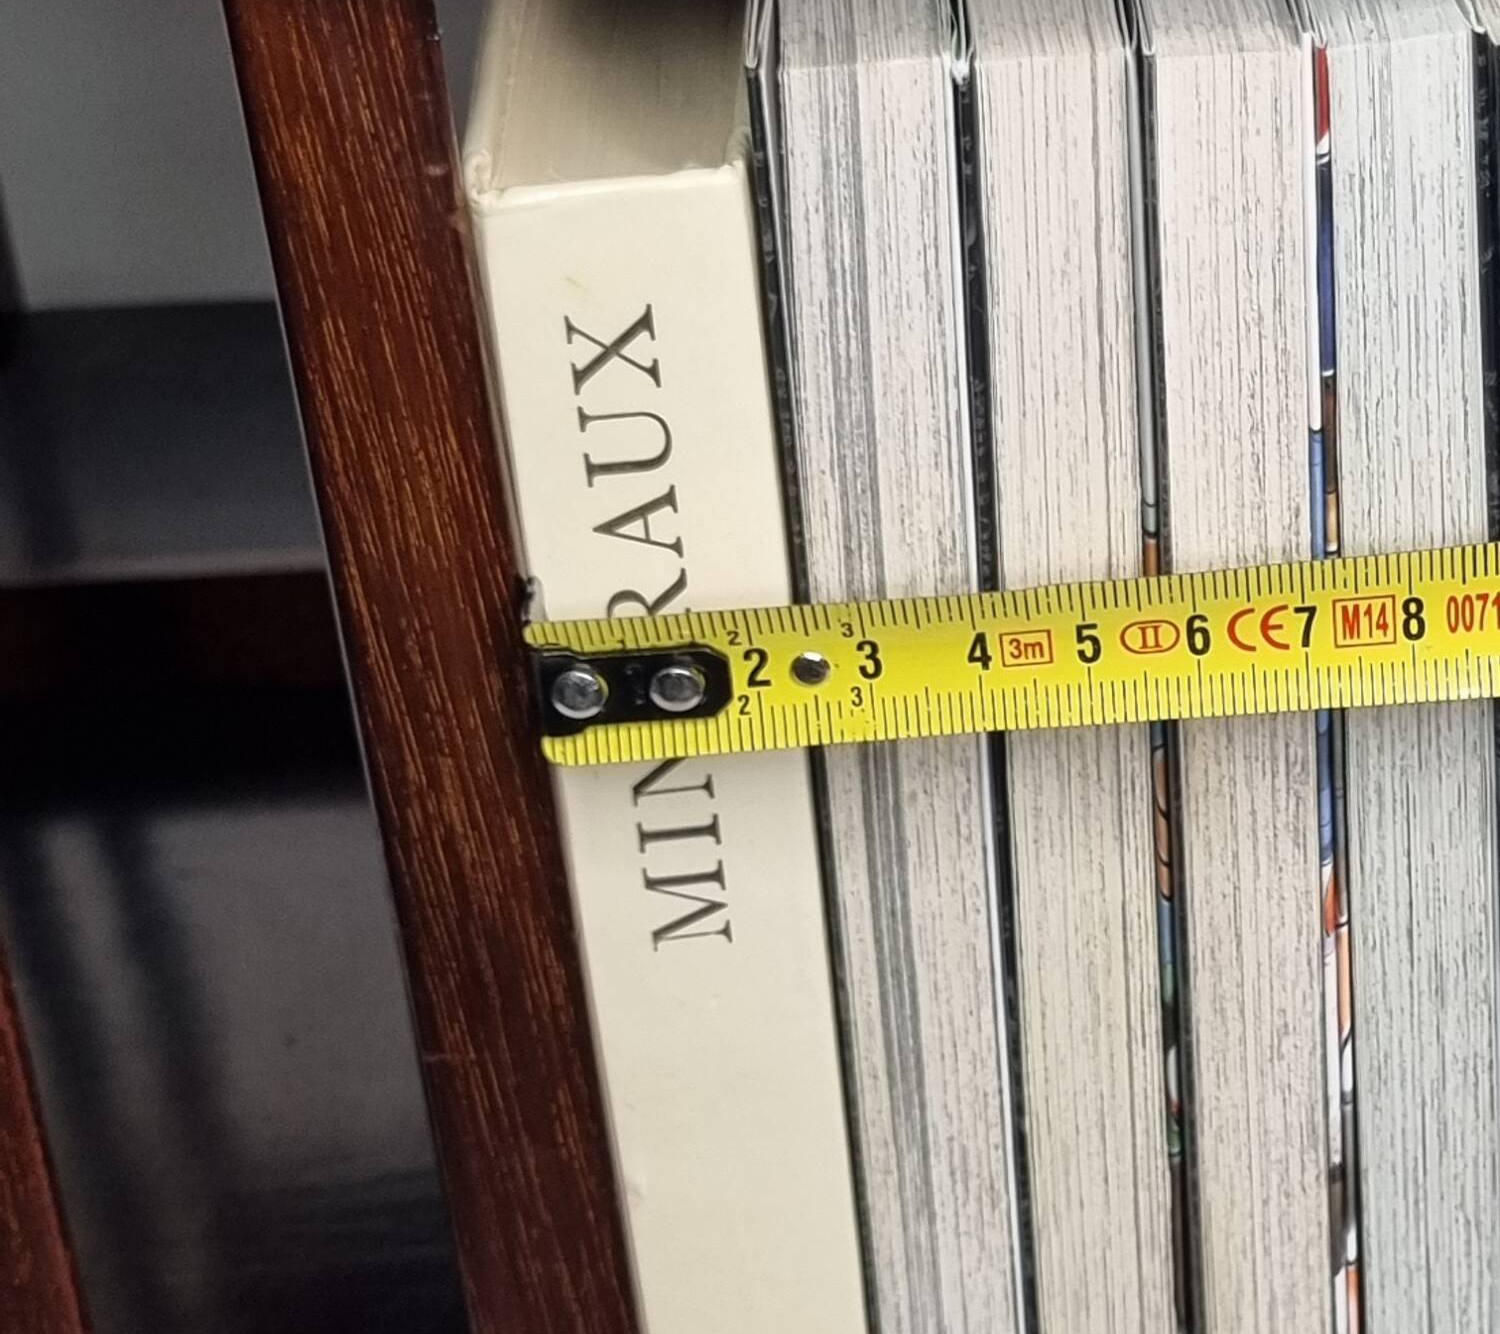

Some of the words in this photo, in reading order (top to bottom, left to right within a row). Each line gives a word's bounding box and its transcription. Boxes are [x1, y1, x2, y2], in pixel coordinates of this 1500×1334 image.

[563, 303, 733, 952] MINRAUX
[743, 647, 772, 688] 2
[857, 639, 883, 680] 3
[967, 632, 992, 670] 4
[1008, 637, 1044, 660] 3m
[1075, 622, 1102, 664] 5
[1185, 613, 1211, 656] 6
[1293, 605, 1318, 648] 7
[1341, 601, 1390, 641] M14
[1402, 596, 1426, 641] 8
[737, 694, 752, 716] 2
[850, 686, 864, 708] 3
